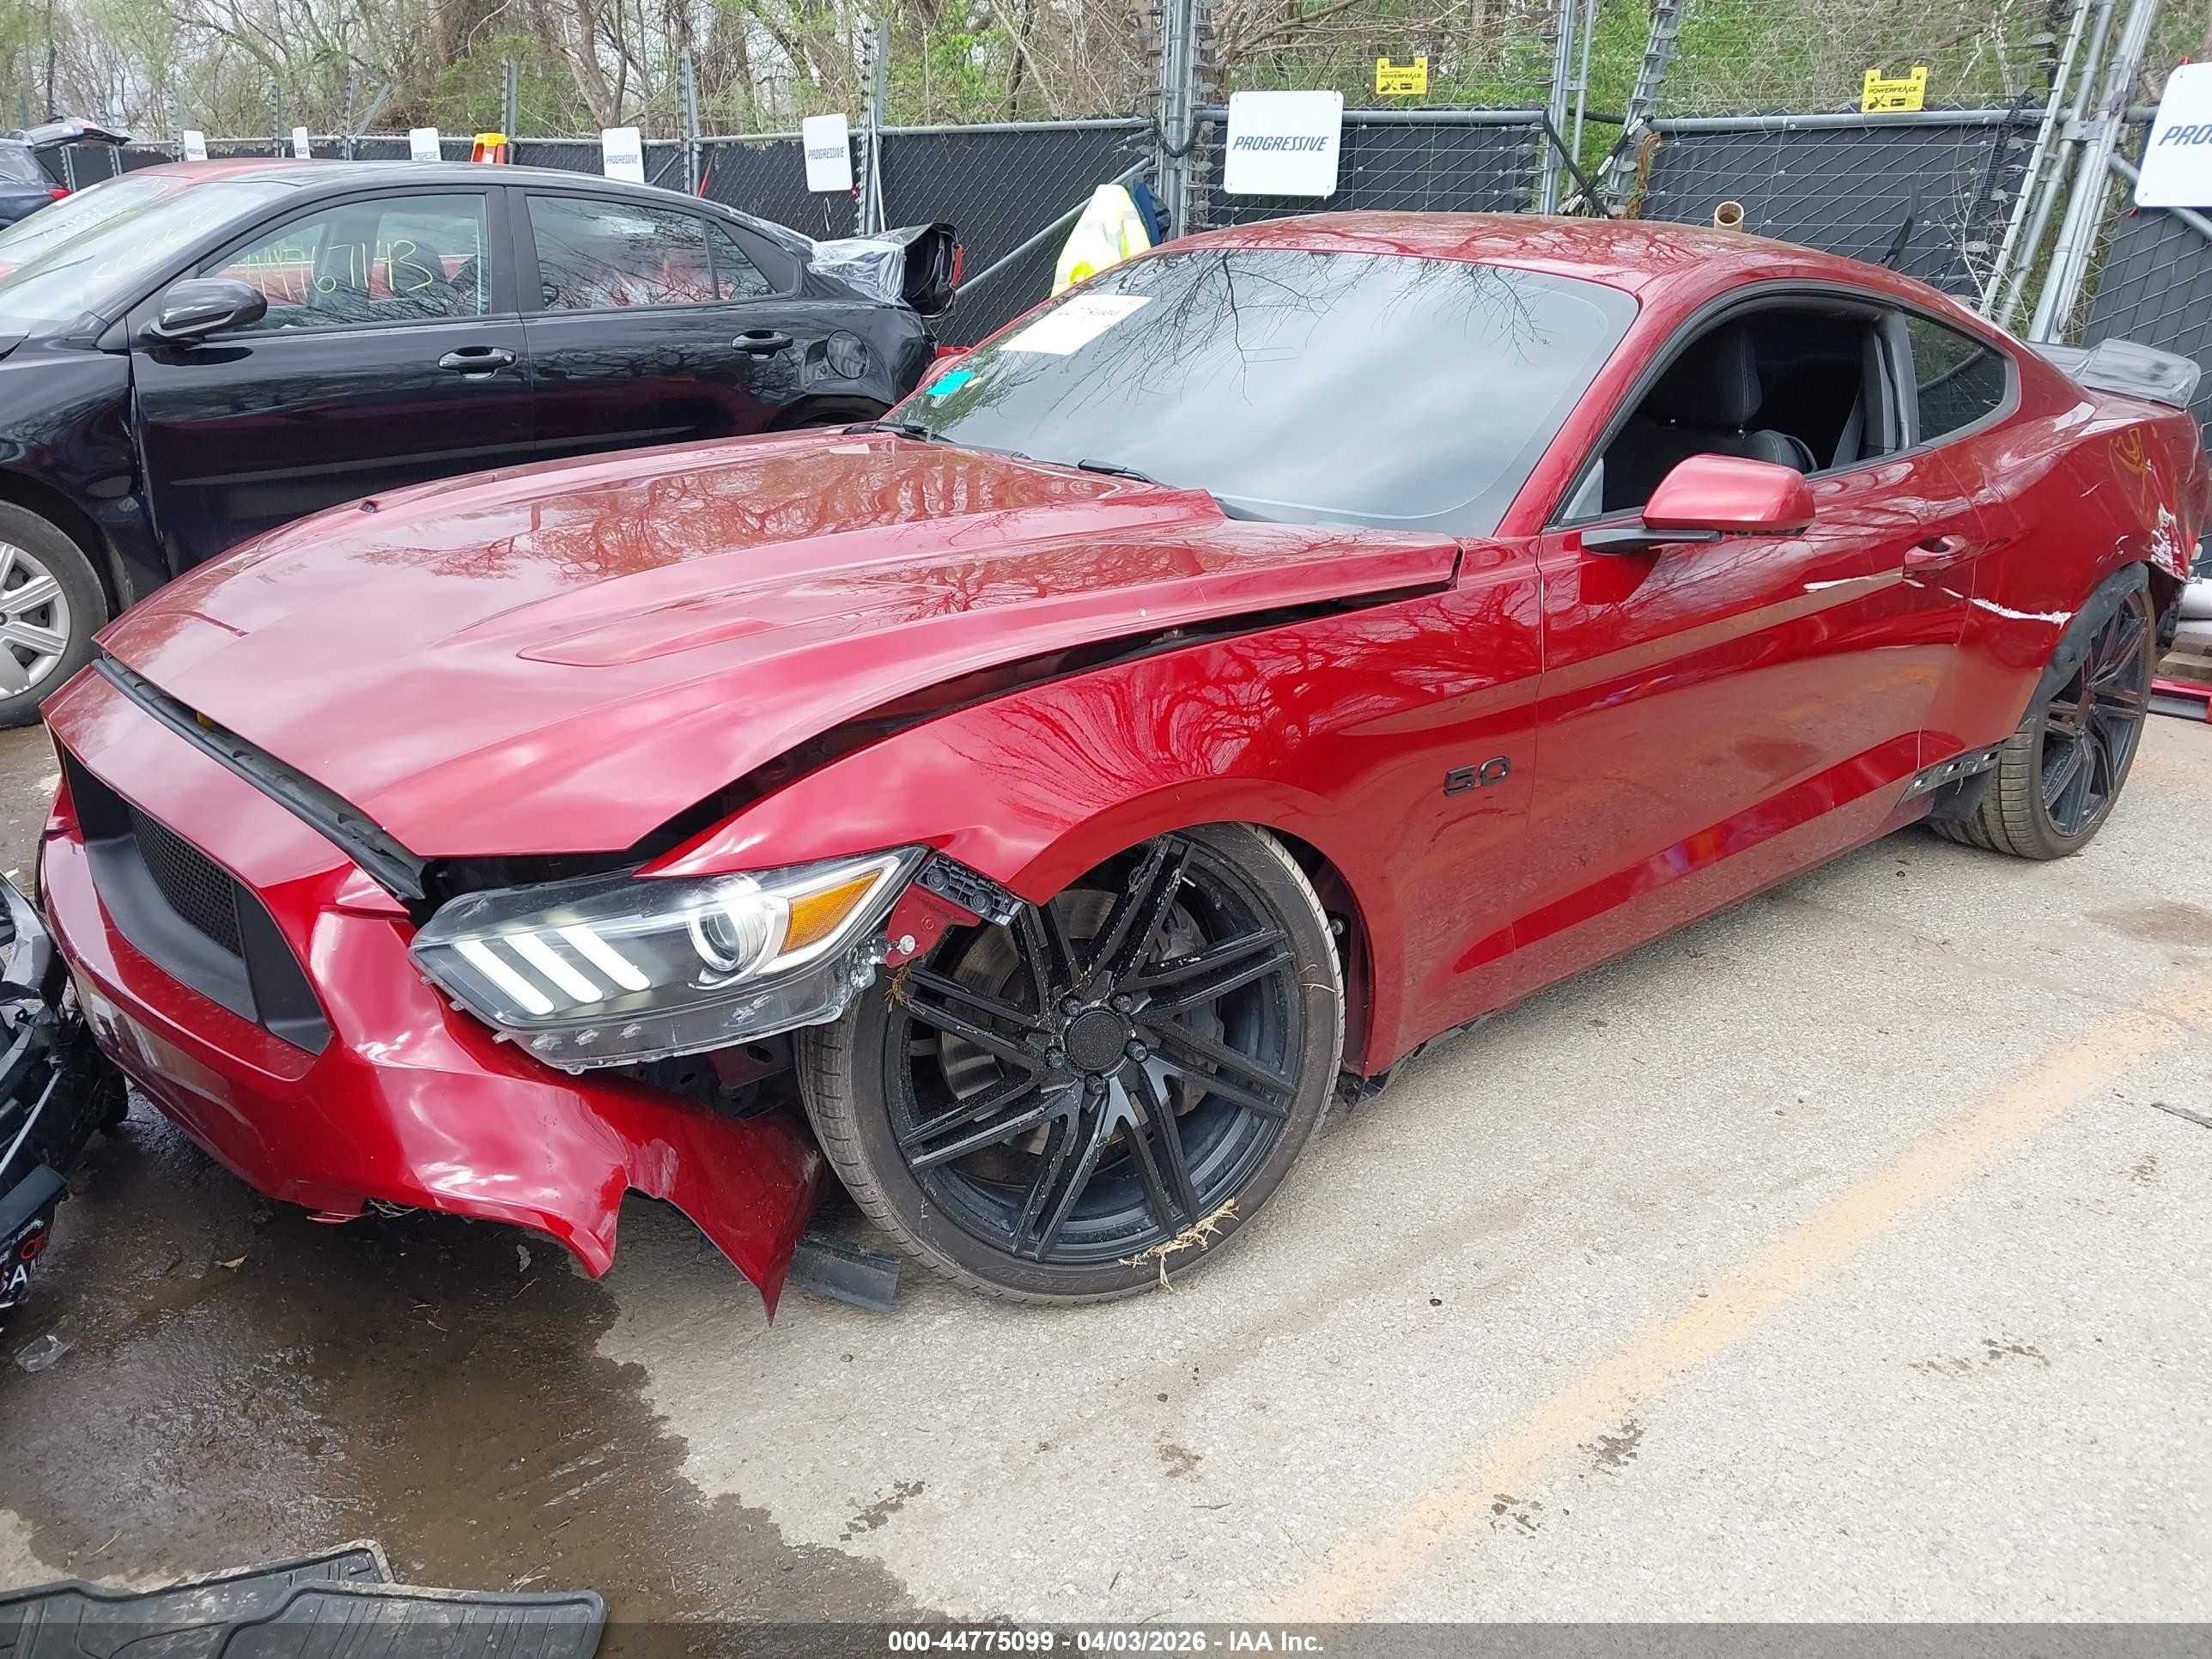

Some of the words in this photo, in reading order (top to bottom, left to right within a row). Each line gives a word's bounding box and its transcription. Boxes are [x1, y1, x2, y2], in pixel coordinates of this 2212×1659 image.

[2158, 124, 2212, 146] PRO
[1232, 136, 1329, 151] PROGRESSIVE
[808, 147, 844, 161] PROGRESSIVE
